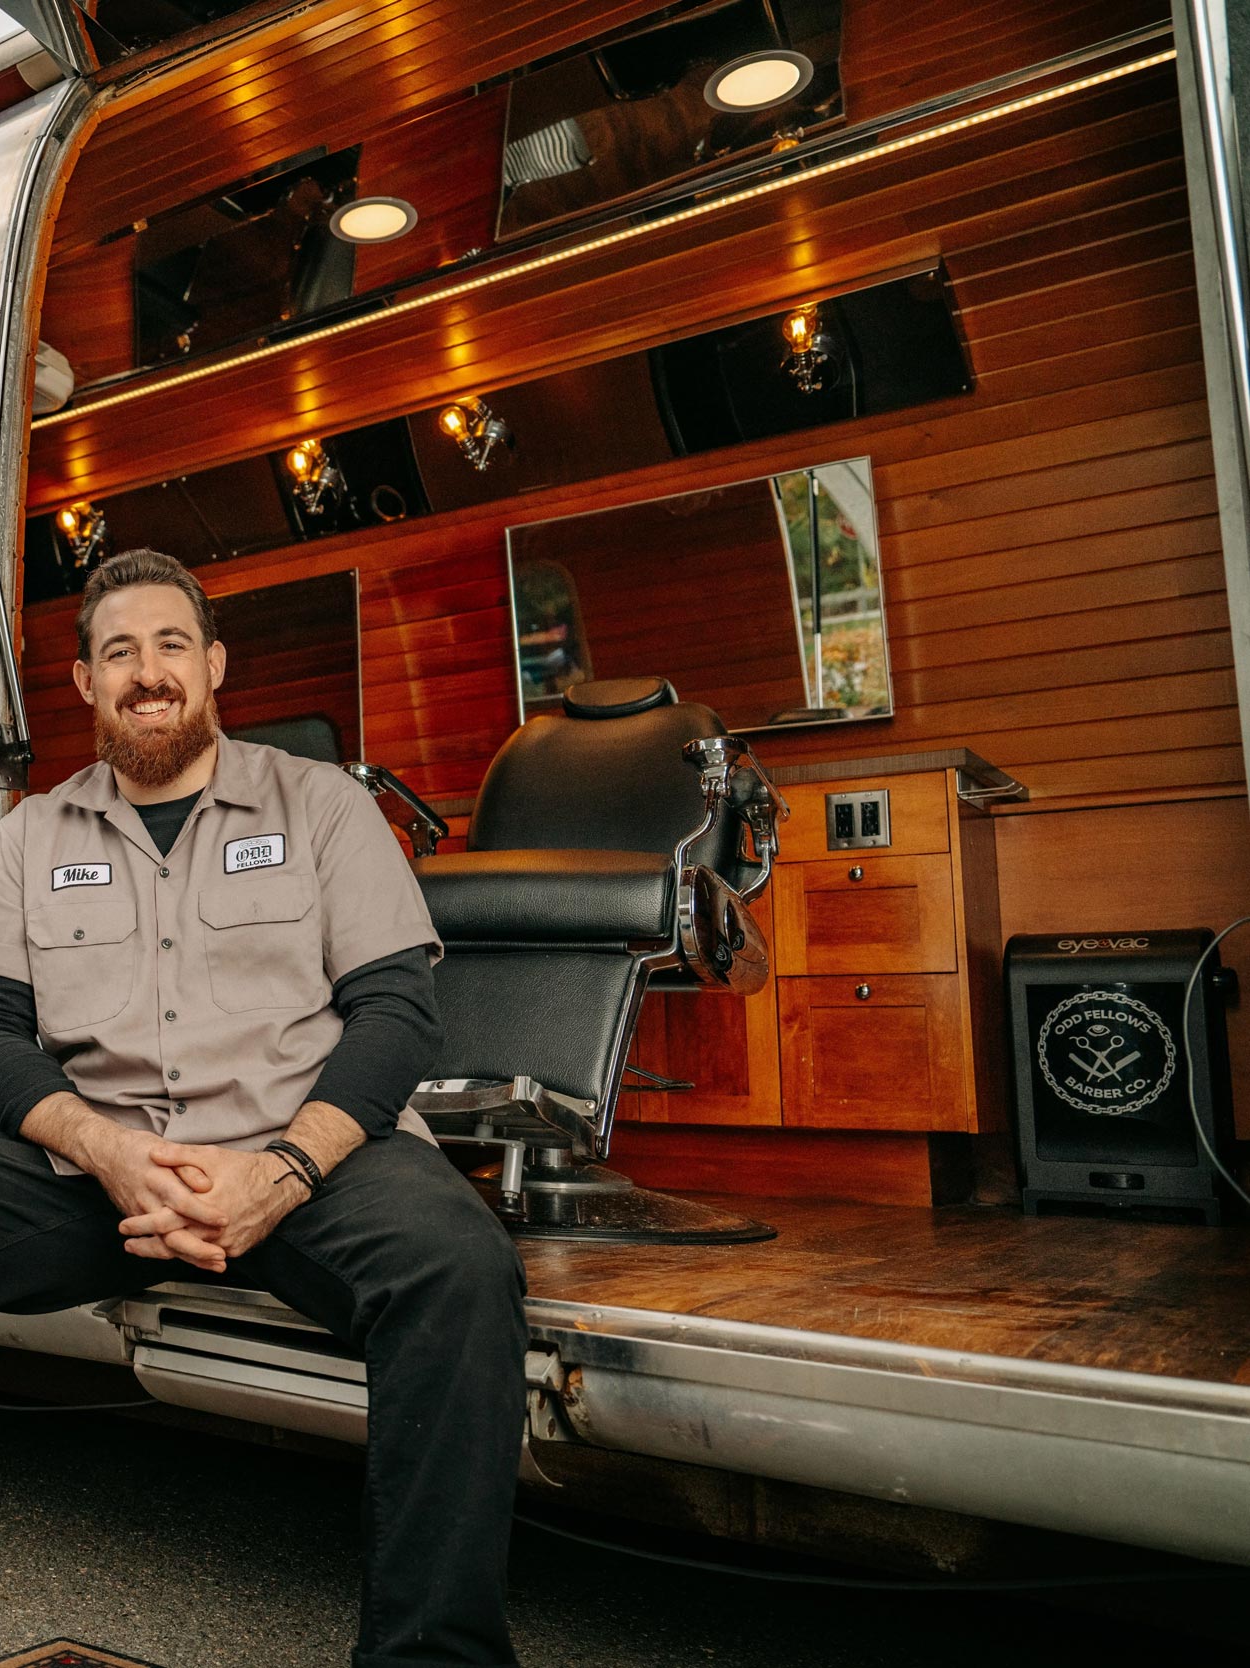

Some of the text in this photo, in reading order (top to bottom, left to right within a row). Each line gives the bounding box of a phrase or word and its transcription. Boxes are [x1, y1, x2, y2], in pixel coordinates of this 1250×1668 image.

[235, 844, 272, 863] ODD
[236, 858, 273, 869] FELLOWS
[63, 867, 100, 884] Mike
[1054, 1009, 1153, 1036] ODD FELLOWS
[1064, 1075, 1152, 1099] BARBER CO.
